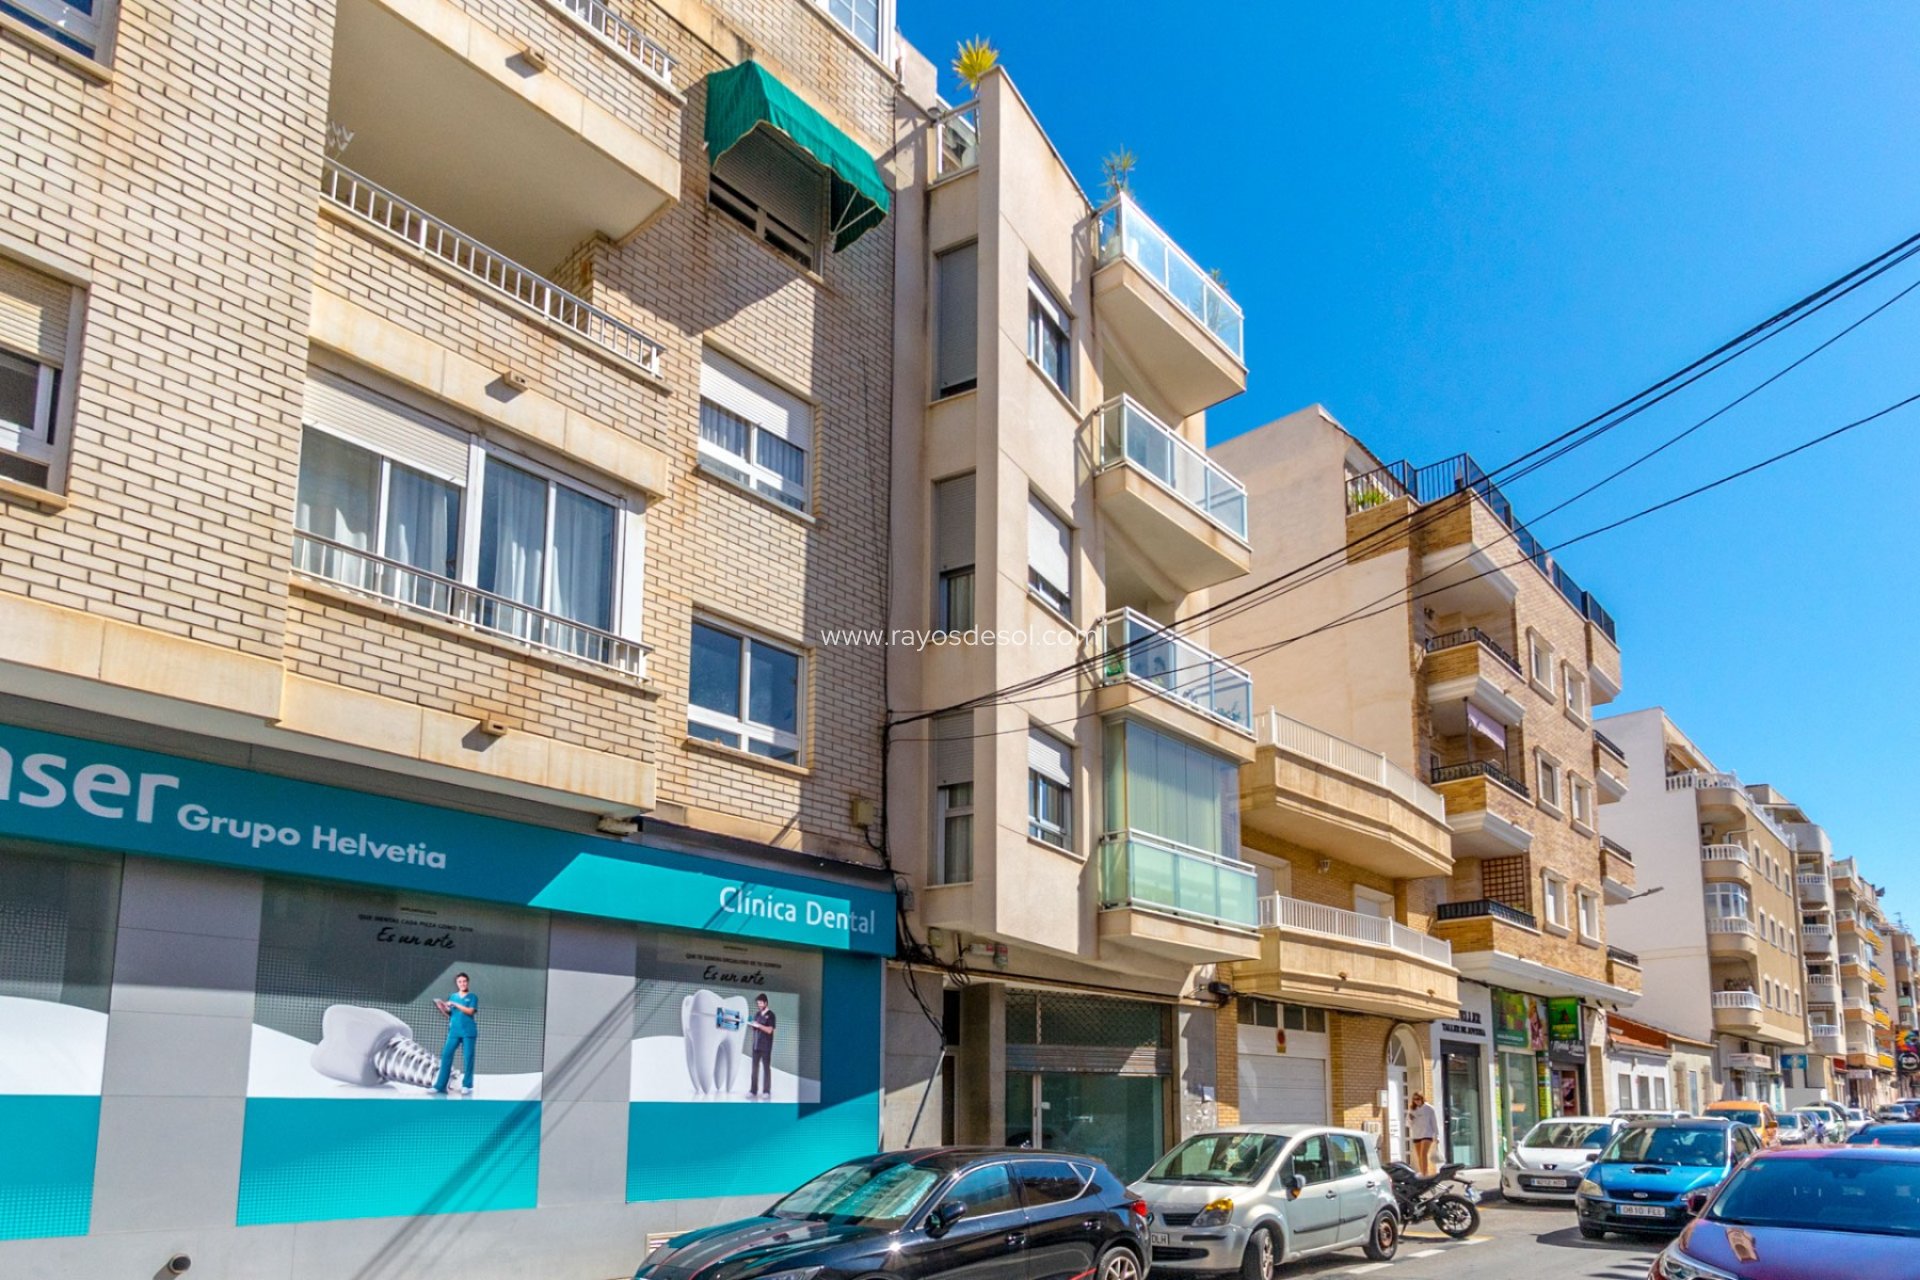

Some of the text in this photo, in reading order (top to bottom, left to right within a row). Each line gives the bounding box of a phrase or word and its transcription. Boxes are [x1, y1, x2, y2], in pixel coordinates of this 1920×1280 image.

[177, 803, 301, 848] Grupo
[312, 825, 447, 869] Helvetia
[719, 886, 875, 935] Clínica Dental
[377, 927, 455, 949] Es un arte
[703, 965, 765, 985] Es un arte
